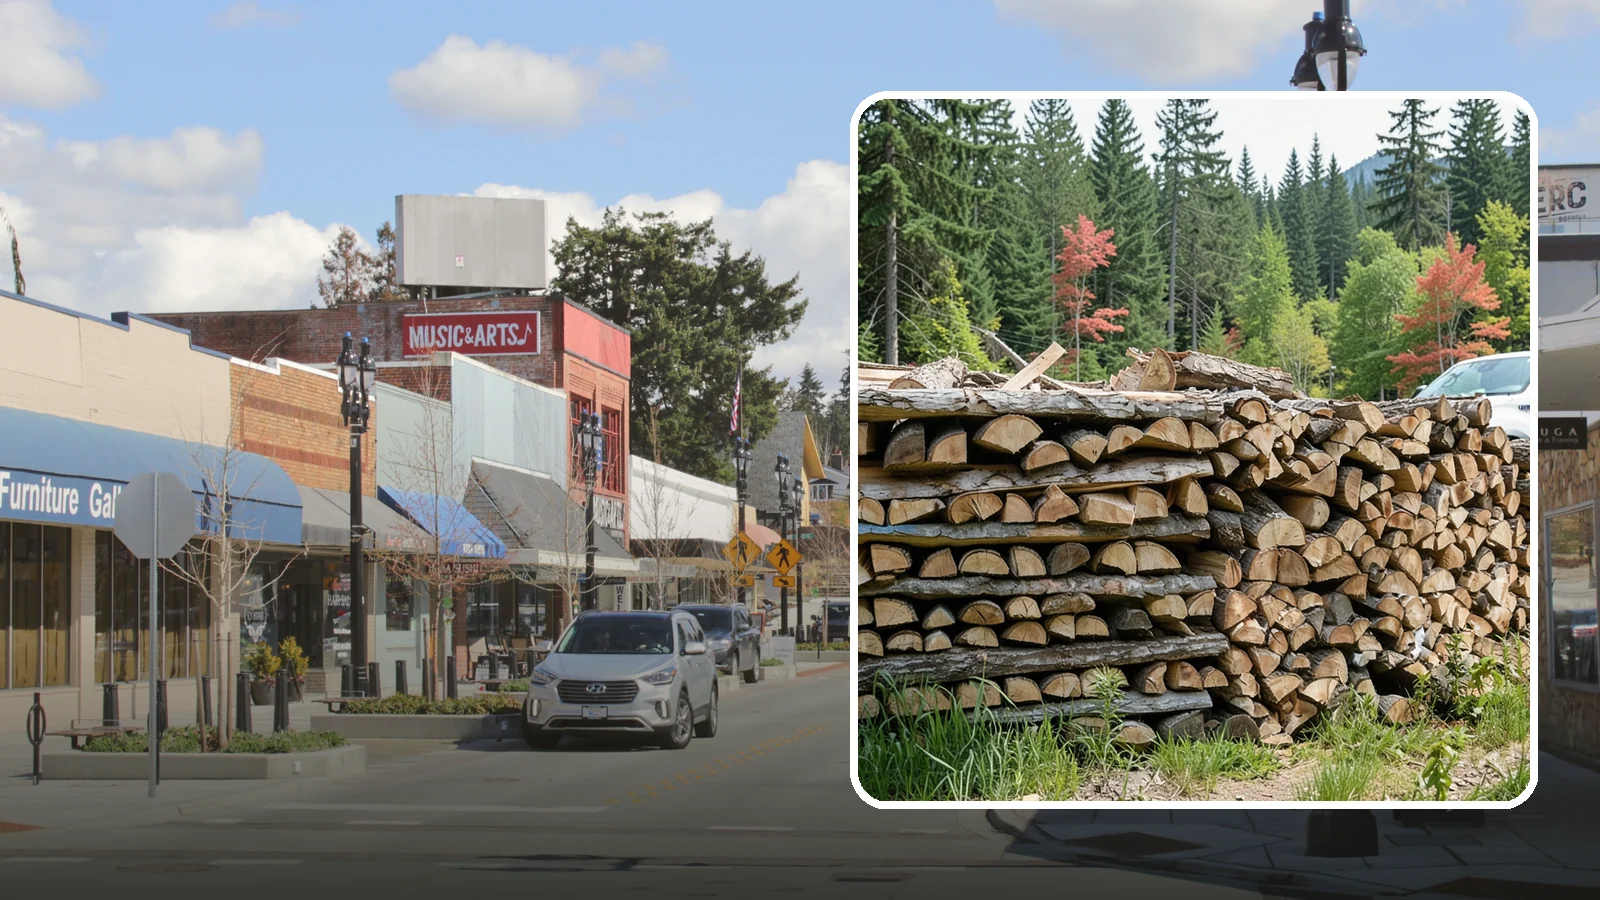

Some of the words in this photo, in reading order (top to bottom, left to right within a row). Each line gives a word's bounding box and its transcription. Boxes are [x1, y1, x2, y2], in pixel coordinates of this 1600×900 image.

[0, 471, 79, 515] Furniture
[89, 482, 122, 519] Gal
[453, 563, 479, 574] SUSHI
